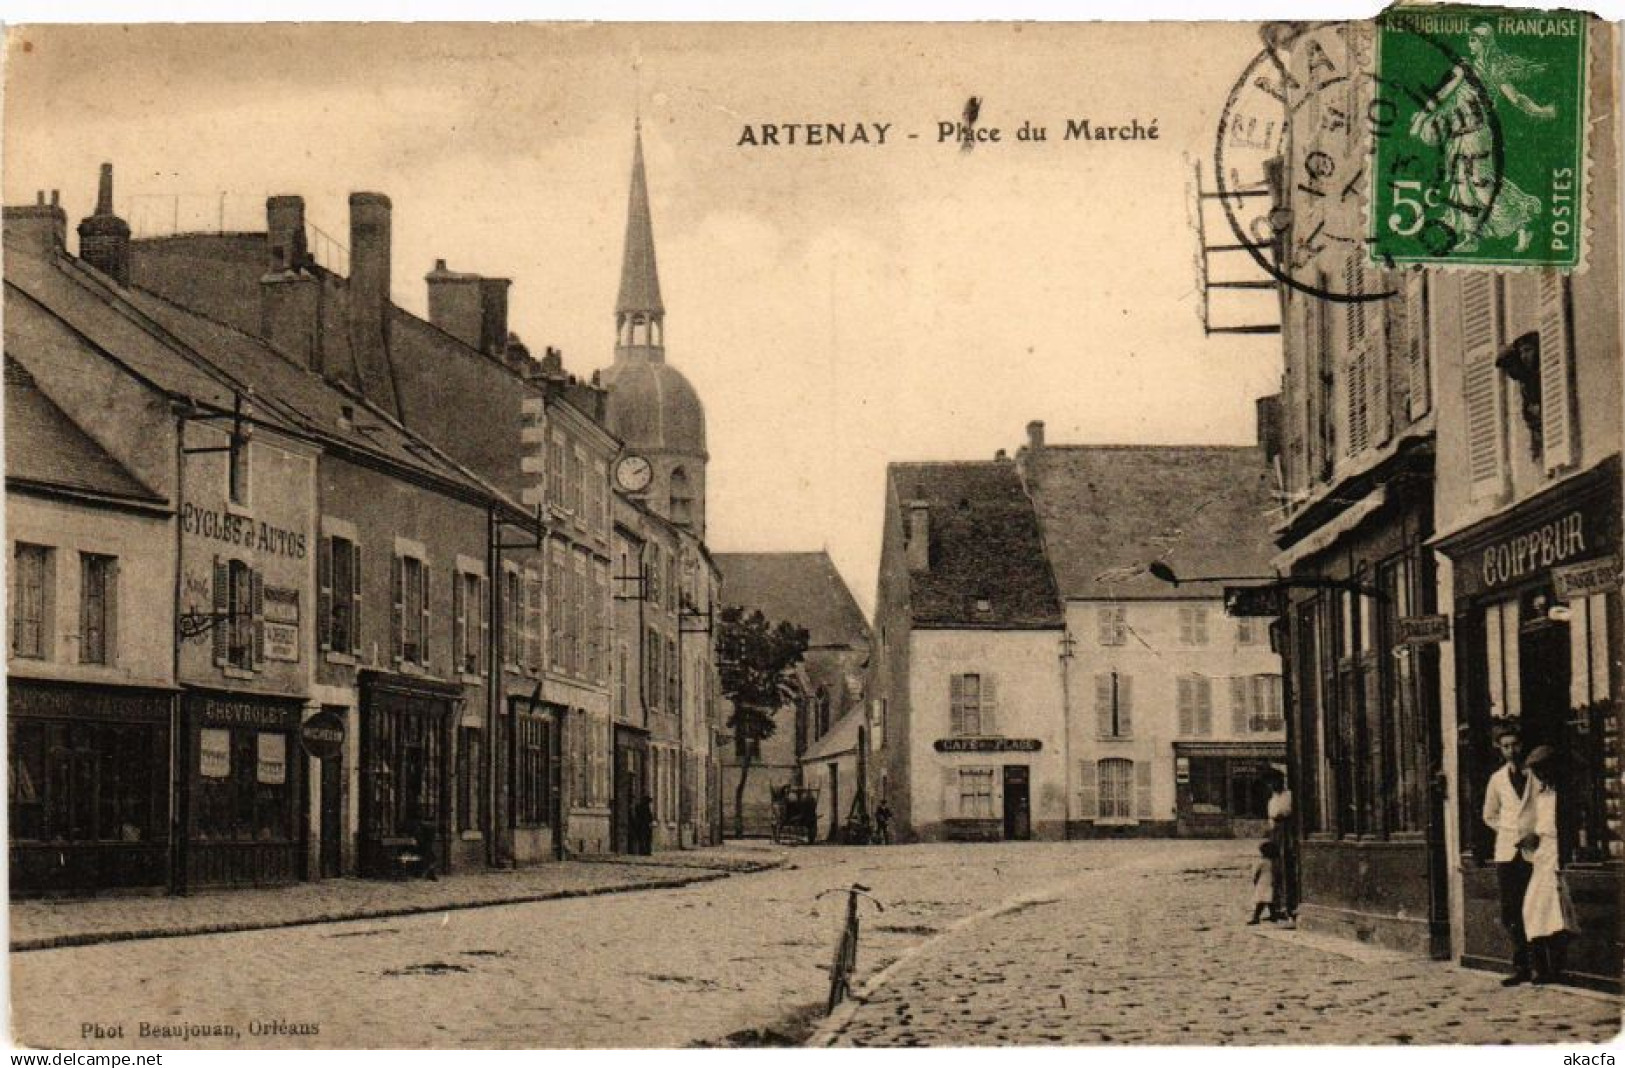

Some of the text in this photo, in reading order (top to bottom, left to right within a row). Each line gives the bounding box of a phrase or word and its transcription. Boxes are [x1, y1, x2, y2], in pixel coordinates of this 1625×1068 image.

[1499, 17, 1577, 38] FRANÇAISE
[737, 122, 893, 146] ARTENAY
[937, 120, 1001, 144] Place
[1017, 120, 1047, 141] du
[1063, 119, 1160, 141] Marché
[1551, 167, 1572, 250] POSTES
[181, 502, 241, 545] CYCLES
[256, 521, 305, 559] AUTOS
[81, 1018, 320, 1041] Phot Beaujouan, Orléans
